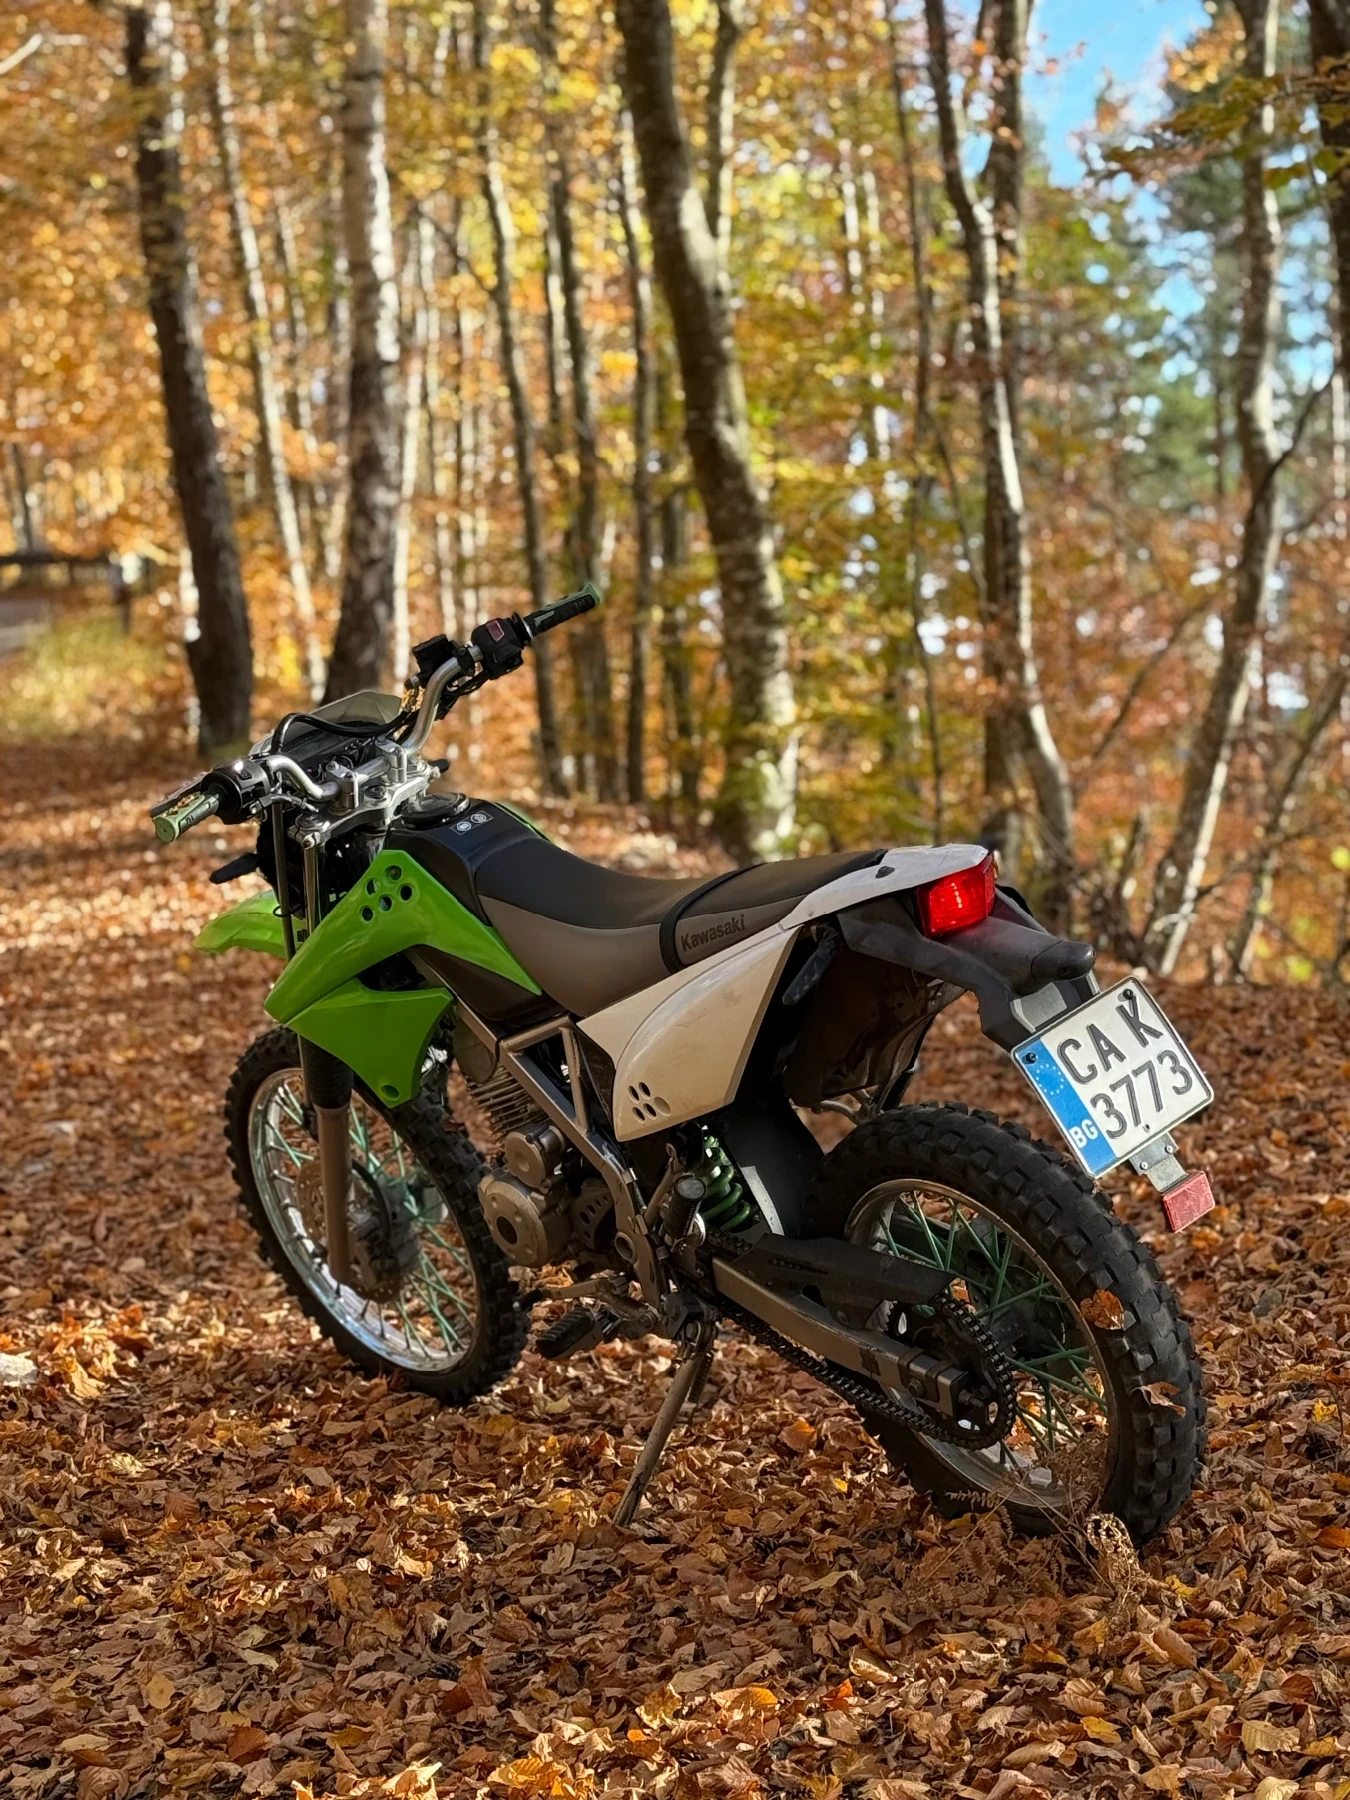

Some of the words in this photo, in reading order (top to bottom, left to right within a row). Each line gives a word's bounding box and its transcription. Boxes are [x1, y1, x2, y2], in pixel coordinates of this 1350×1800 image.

[681, 914, 746, 952] Kawasaki
[1057, 1023, 1127, 1085] CA
[1115, 993, 1164, 1048] K
[1090, 1050, 1193, 1140] 3773
[1068, 1119, 1099, 1149] BG
